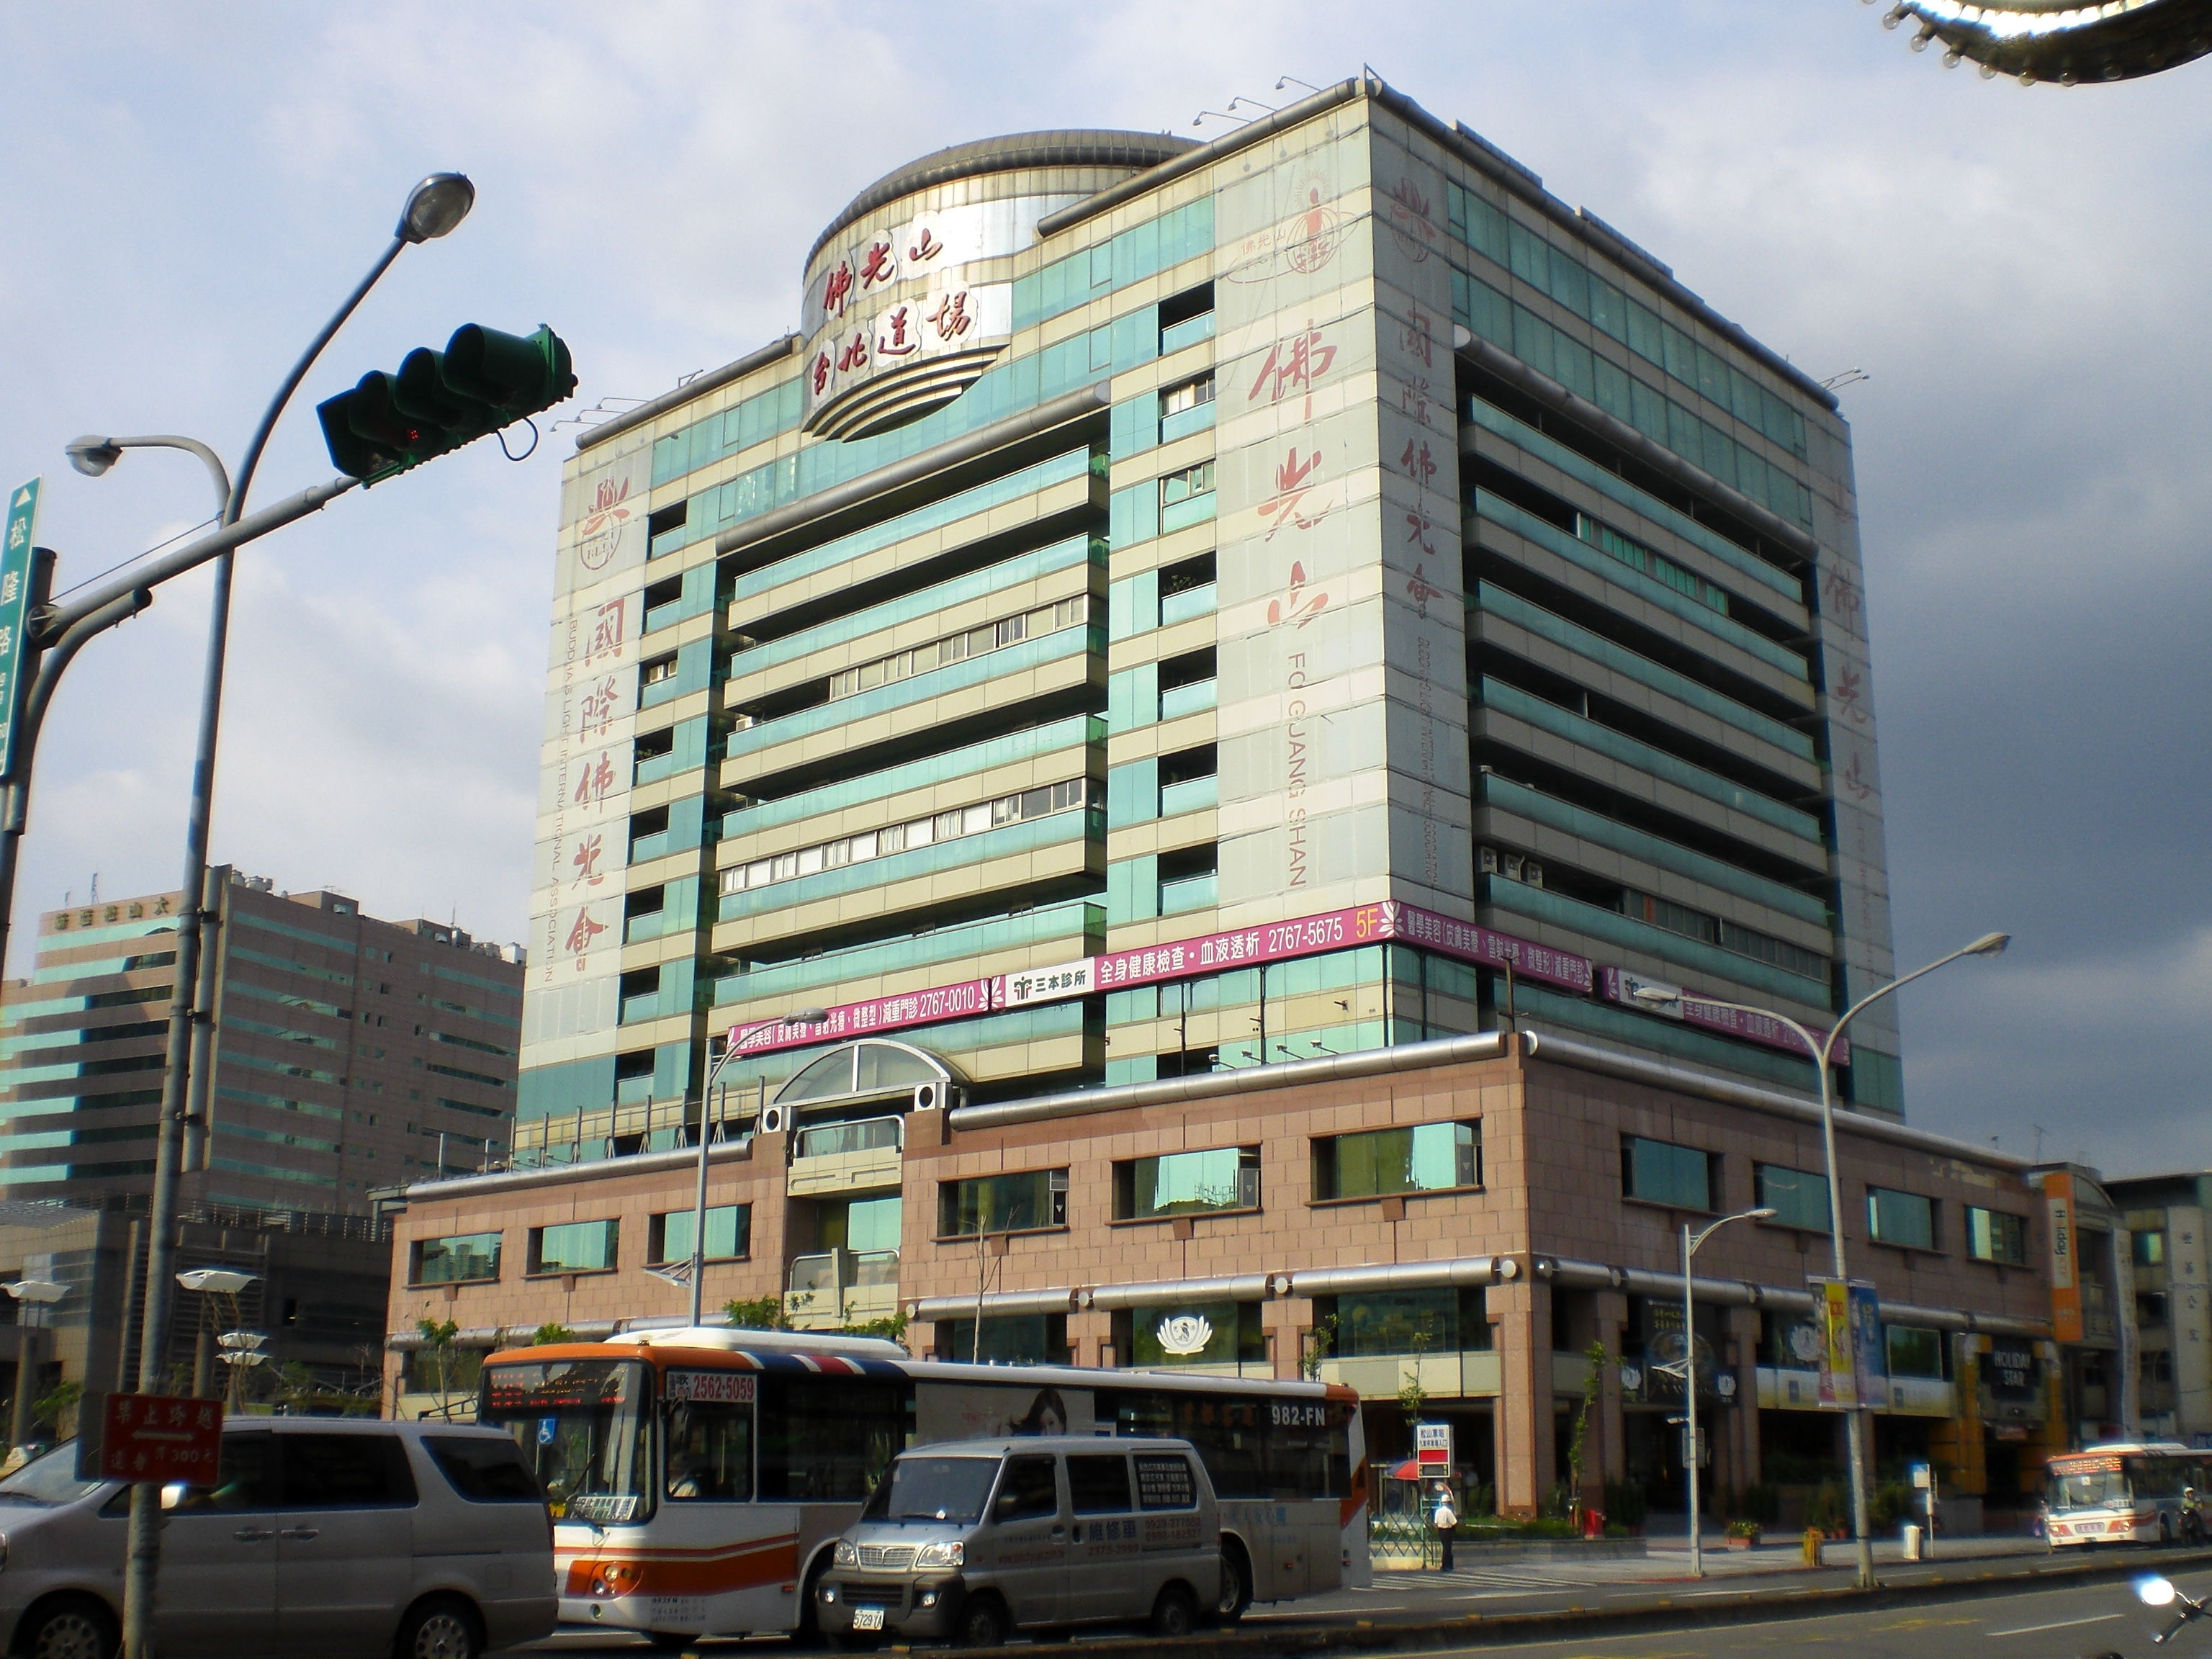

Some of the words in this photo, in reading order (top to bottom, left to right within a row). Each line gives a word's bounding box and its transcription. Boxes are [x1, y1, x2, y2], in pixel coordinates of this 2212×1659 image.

[1241, 228, 1287, 255] 佛光山
[822, 228, 943, 318] 佛光山
[812, 290, 971, 395] 台北道場
[1248, 318, 1337, 630] 佛光山
[1287, 652, 1306, 689] FO
[1287, 699, 1308, 799] GUANG
[565, 598, 624, 972] 國際佛光會
[1289, 808, 1308, 888] SHAN
[1268, 917, 1344, 953] 2767-5675
[1355, 907, 1378, 938] 5F
[1035, 968, 1087, 993] 三本診所
[920, 985, 975, 1017] 2767-0010
[1995, 1350, 2031, 1369] HOLIDAY
[2004, 1370, 2026, 1387] STAR
[115, 1400, 215, 1430] 禁止跨越
[1272, 1406, 1326, 1426] 982-FN
[1089, 1520, 1136, 1542] 維修車
